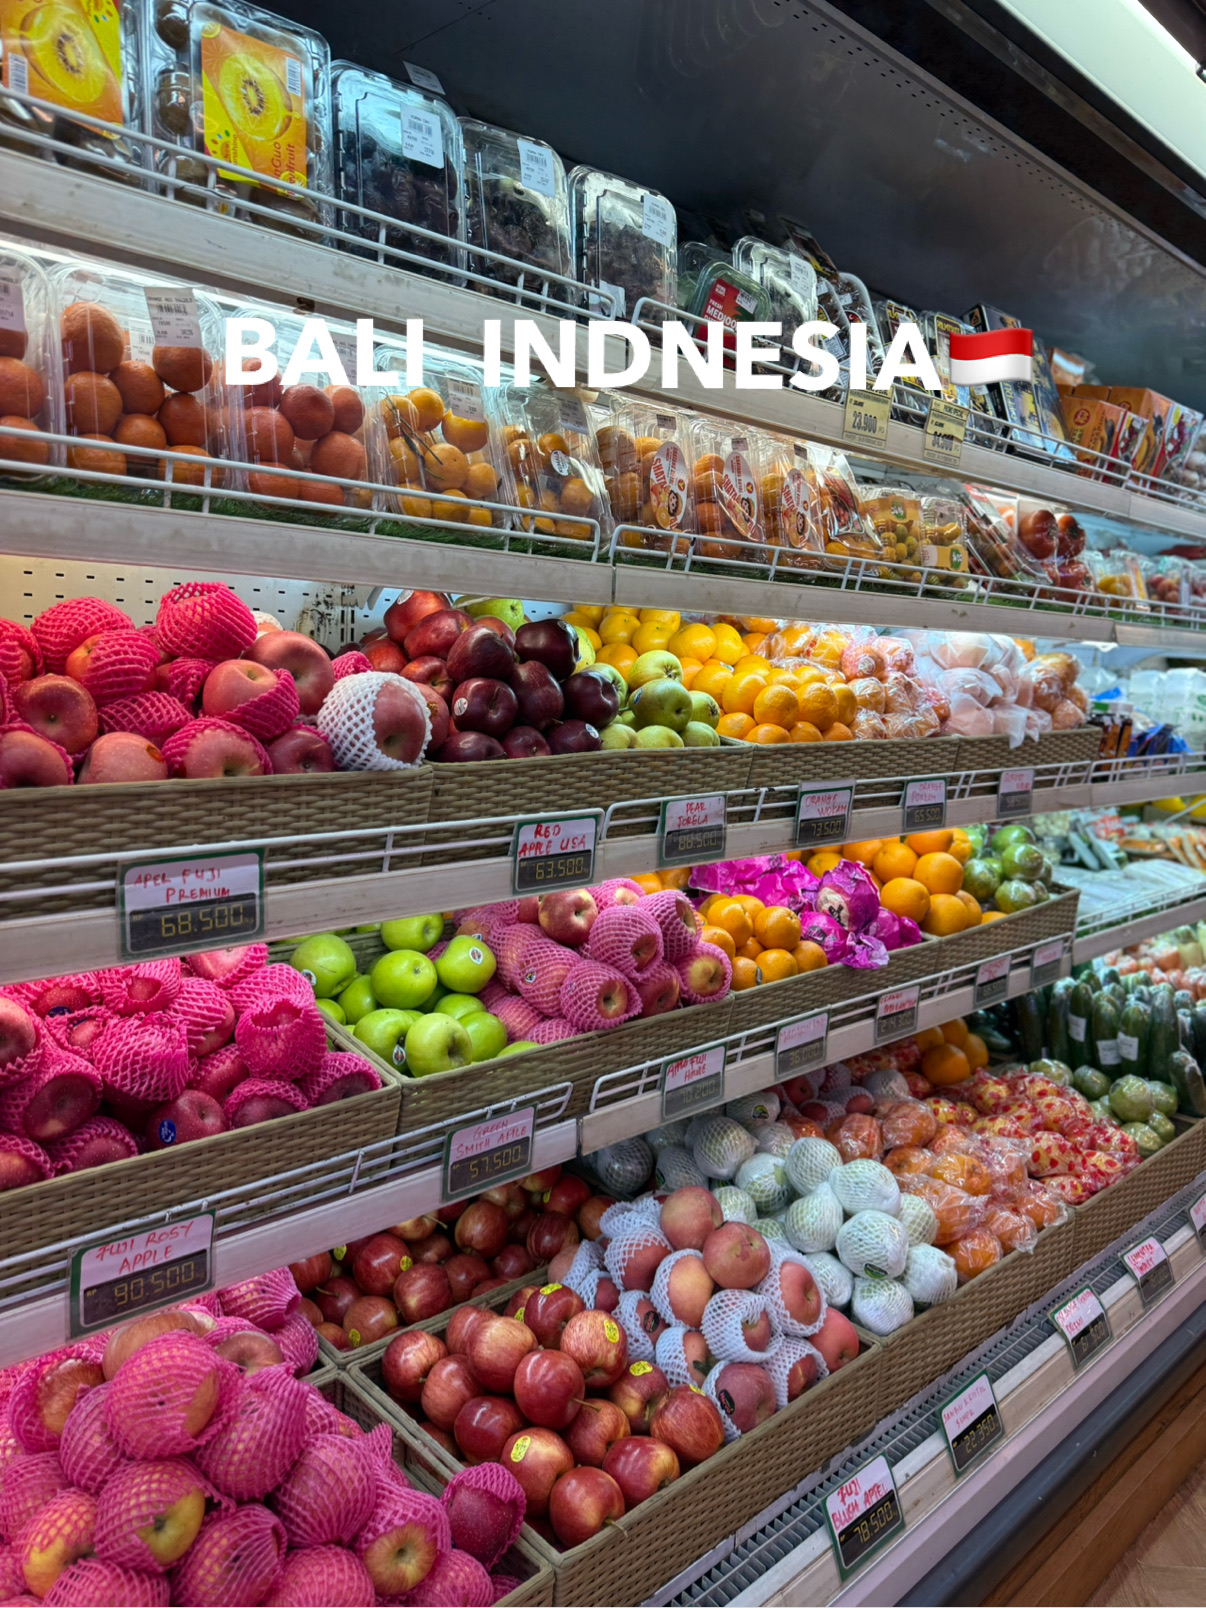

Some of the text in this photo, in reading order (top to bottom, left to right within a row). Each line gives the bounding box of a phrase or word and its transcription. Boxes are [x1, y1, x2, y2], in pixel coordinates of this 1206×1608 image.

[533, 823, 562, 839] RED
[560, 834, 586, 851] USA
[181, 867, 222, 885] FUJI
[535, 856, 584, 880] 63.500
[165, 886, 231, 904] PREMIUM
[161, 903, 244, 938] 68.500
[473, 1119, 509, 1141] GREEN
[455, 1138, 491, 1160] SMITH
[469, 1145, 521, 1179] 57.500
[96, 1220, 195, 1262] FUJI ROSY
[119, 1245, 173, 1275] APPLE
[86, 1288, 98, 1298] RP
[114, 1261, 195, 1306] 90.500
[831, 1499, 860, 1531] BLUSH
[853, 1501, 894, 1543] 78.500
